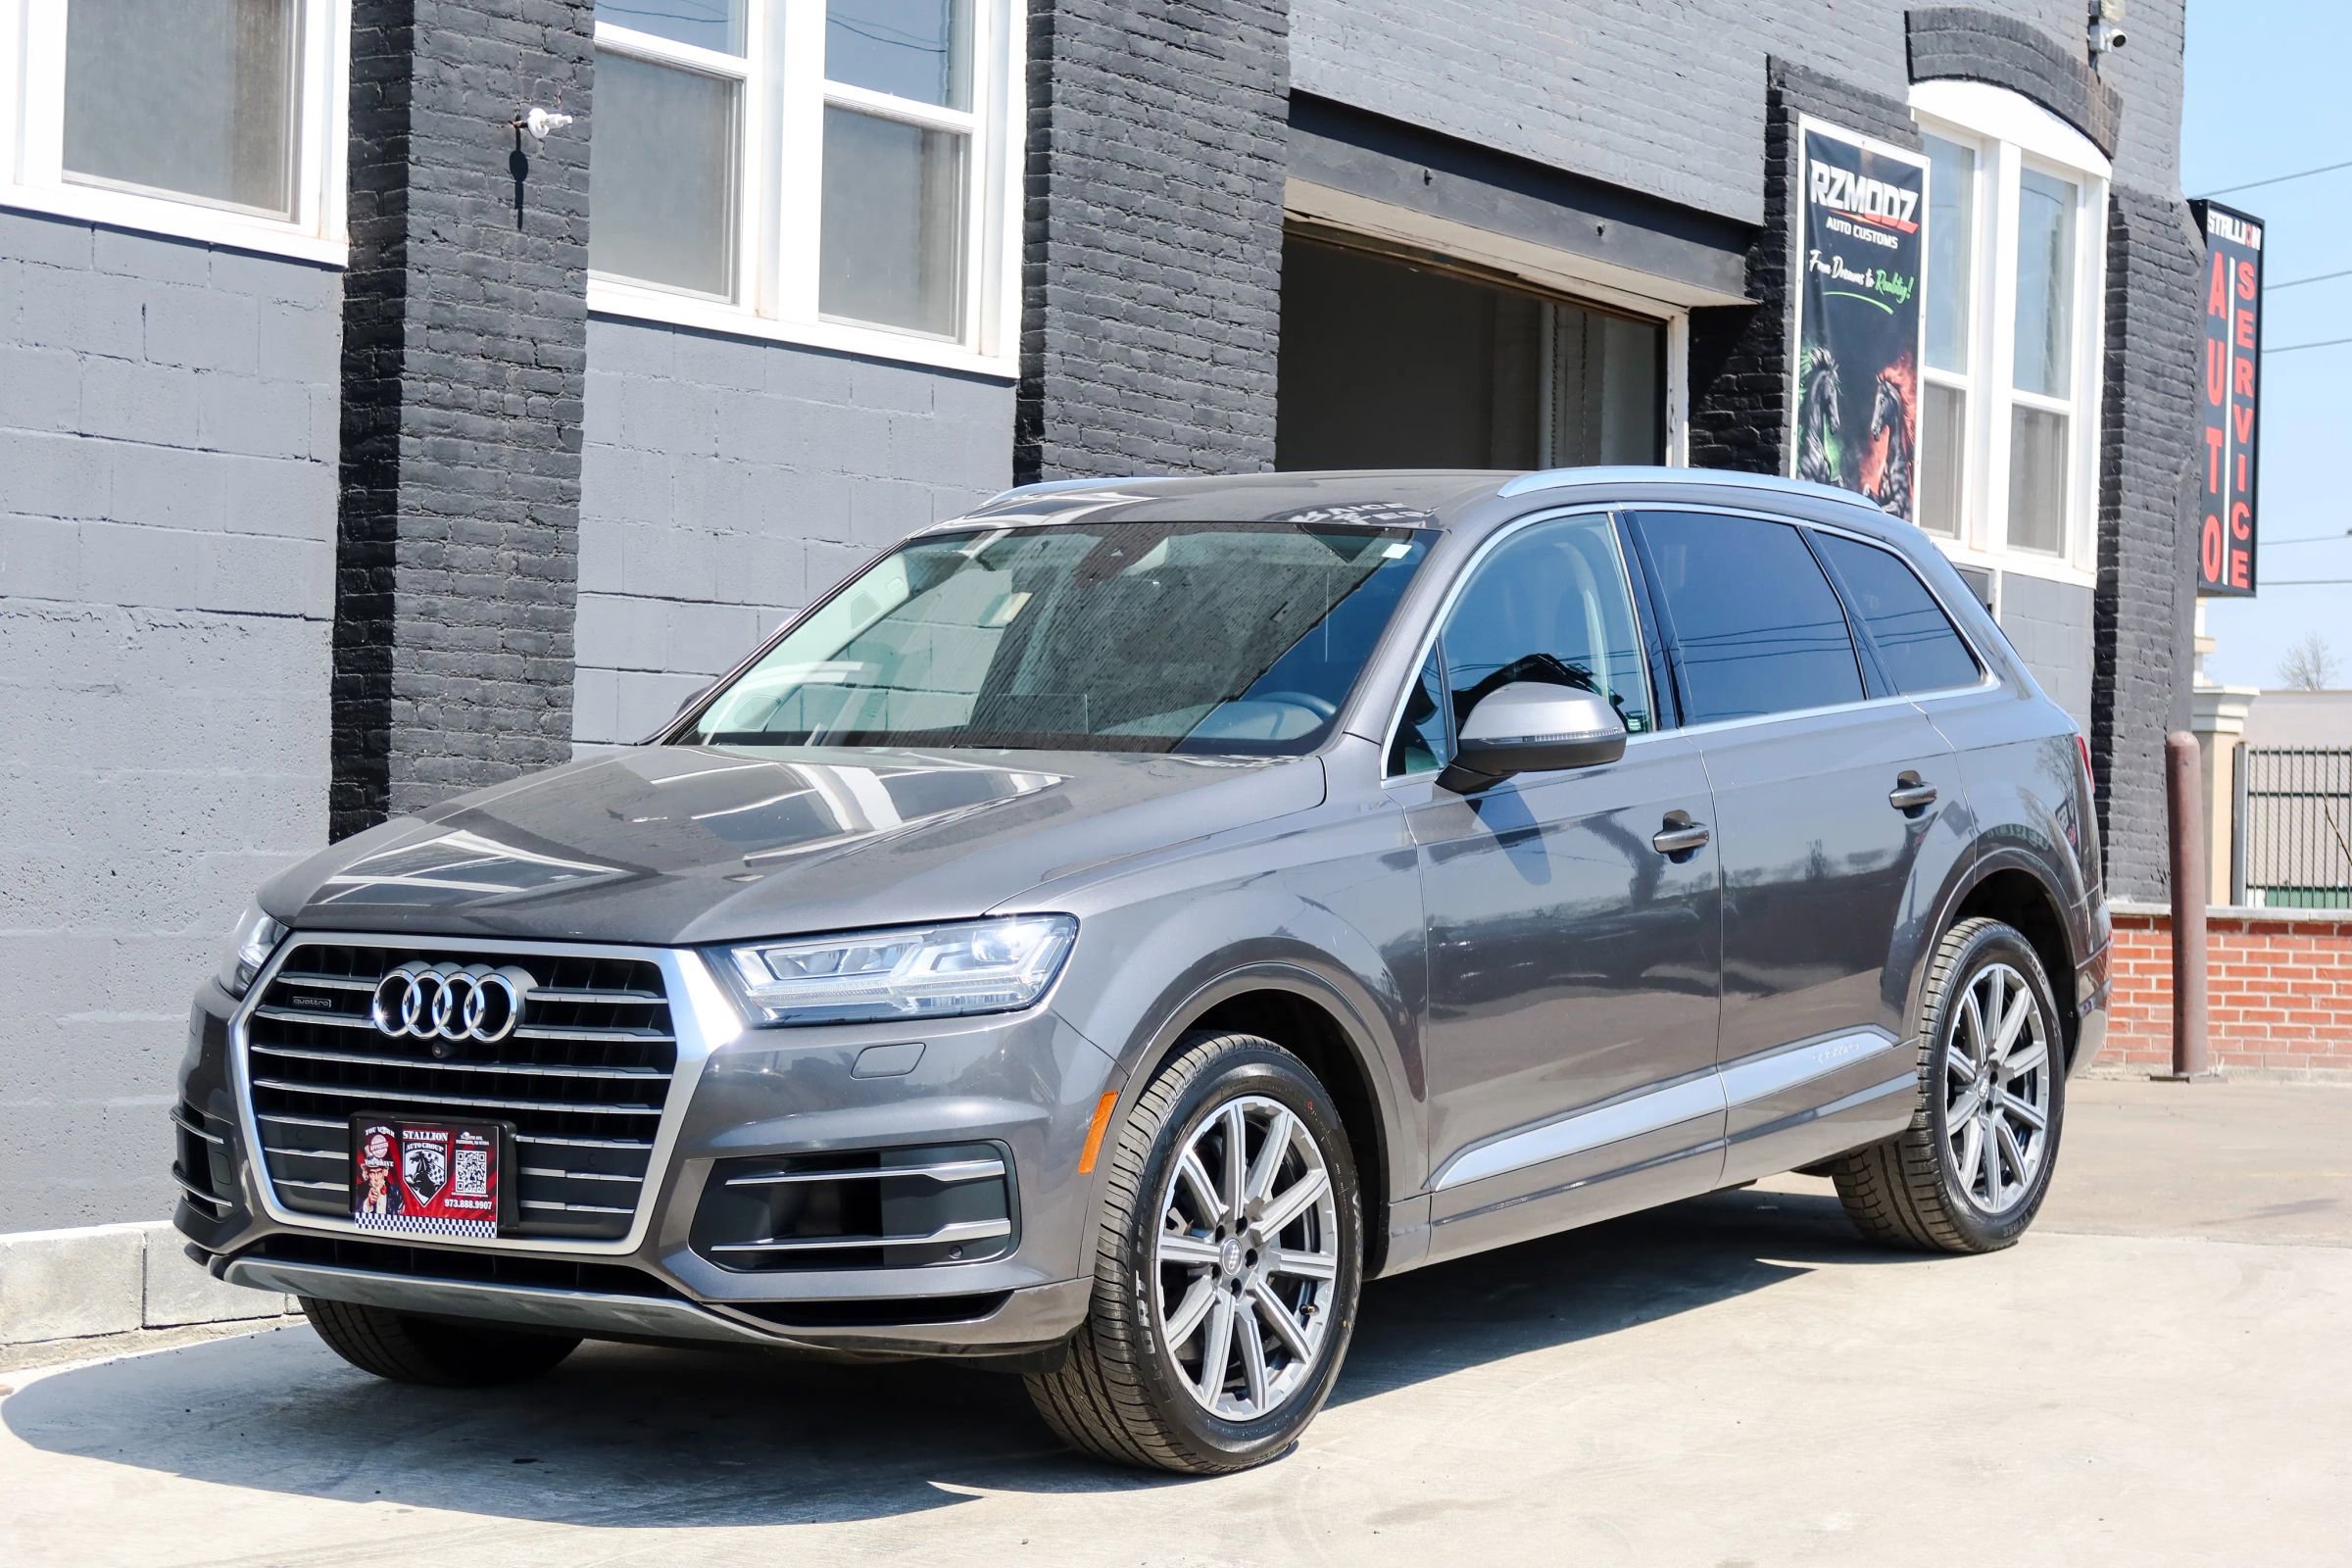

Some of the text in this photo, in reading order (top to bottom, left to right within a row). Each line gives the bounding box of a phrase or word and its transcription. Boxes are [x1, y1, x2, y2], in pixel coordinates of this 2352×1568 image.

[1810, 159, 1919, 233] RZMODZ
[1826, 217, 1898, 249] AUTO CUSTOMS
[2207, 209, 2262, 251] STALLION
[1831, 255, 1865, 285] Dreams
[1865, 268, 1875, 288] to
[1874, 270, 1915, 304] Reality!
[2201, 251, 2227, 584] AUTO
[2230, 261, 2255, 588] SERVICE
[293, 998, 329, 1006] quattro
[403, 1130, 449, 1141] STALLION
[421, 1143, 444, 1152] GROUP
